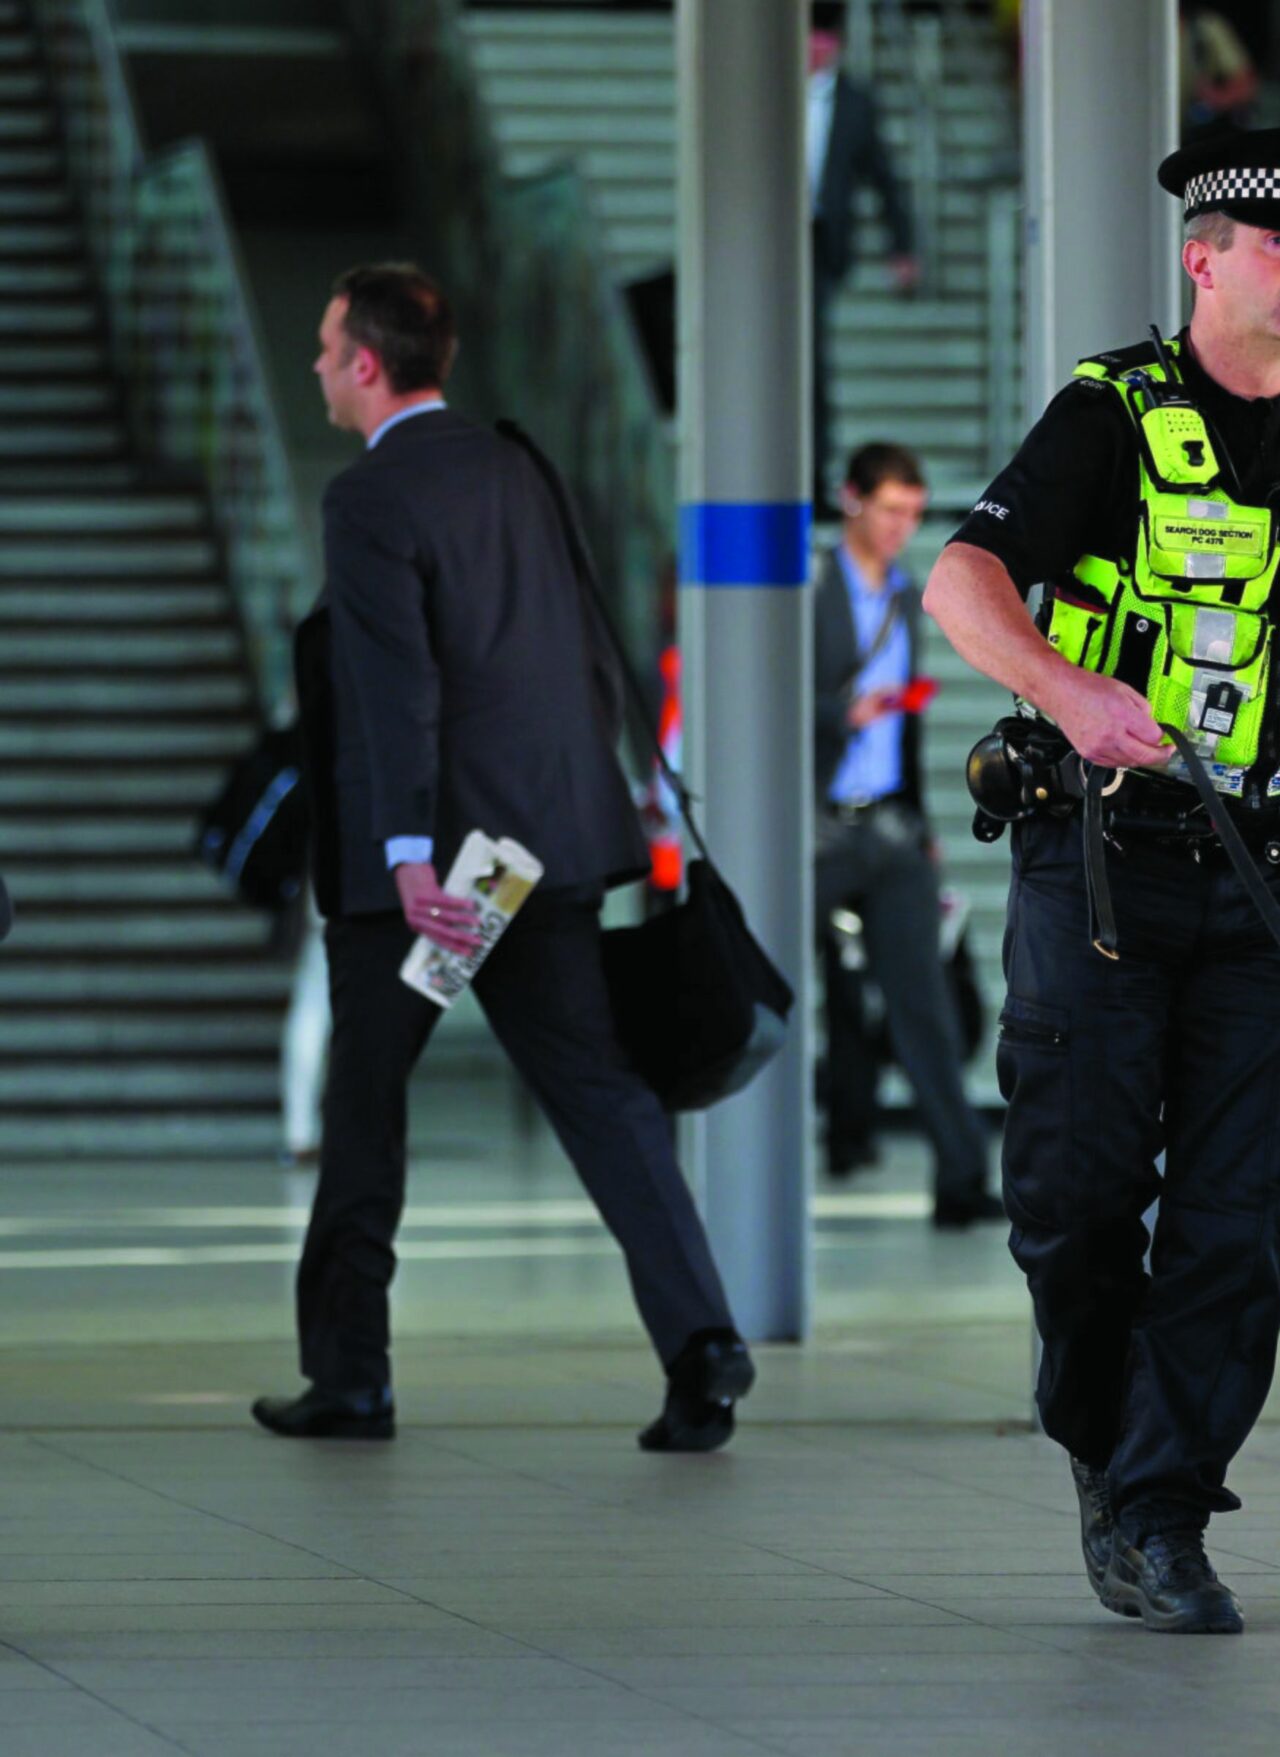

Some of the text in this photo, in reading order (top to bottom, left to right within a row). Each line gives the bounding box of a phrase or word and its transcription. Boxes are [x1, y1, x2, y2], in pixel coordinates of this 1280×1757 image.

[1165, 526, 1252, 539] SEARCH DOG SECTION
